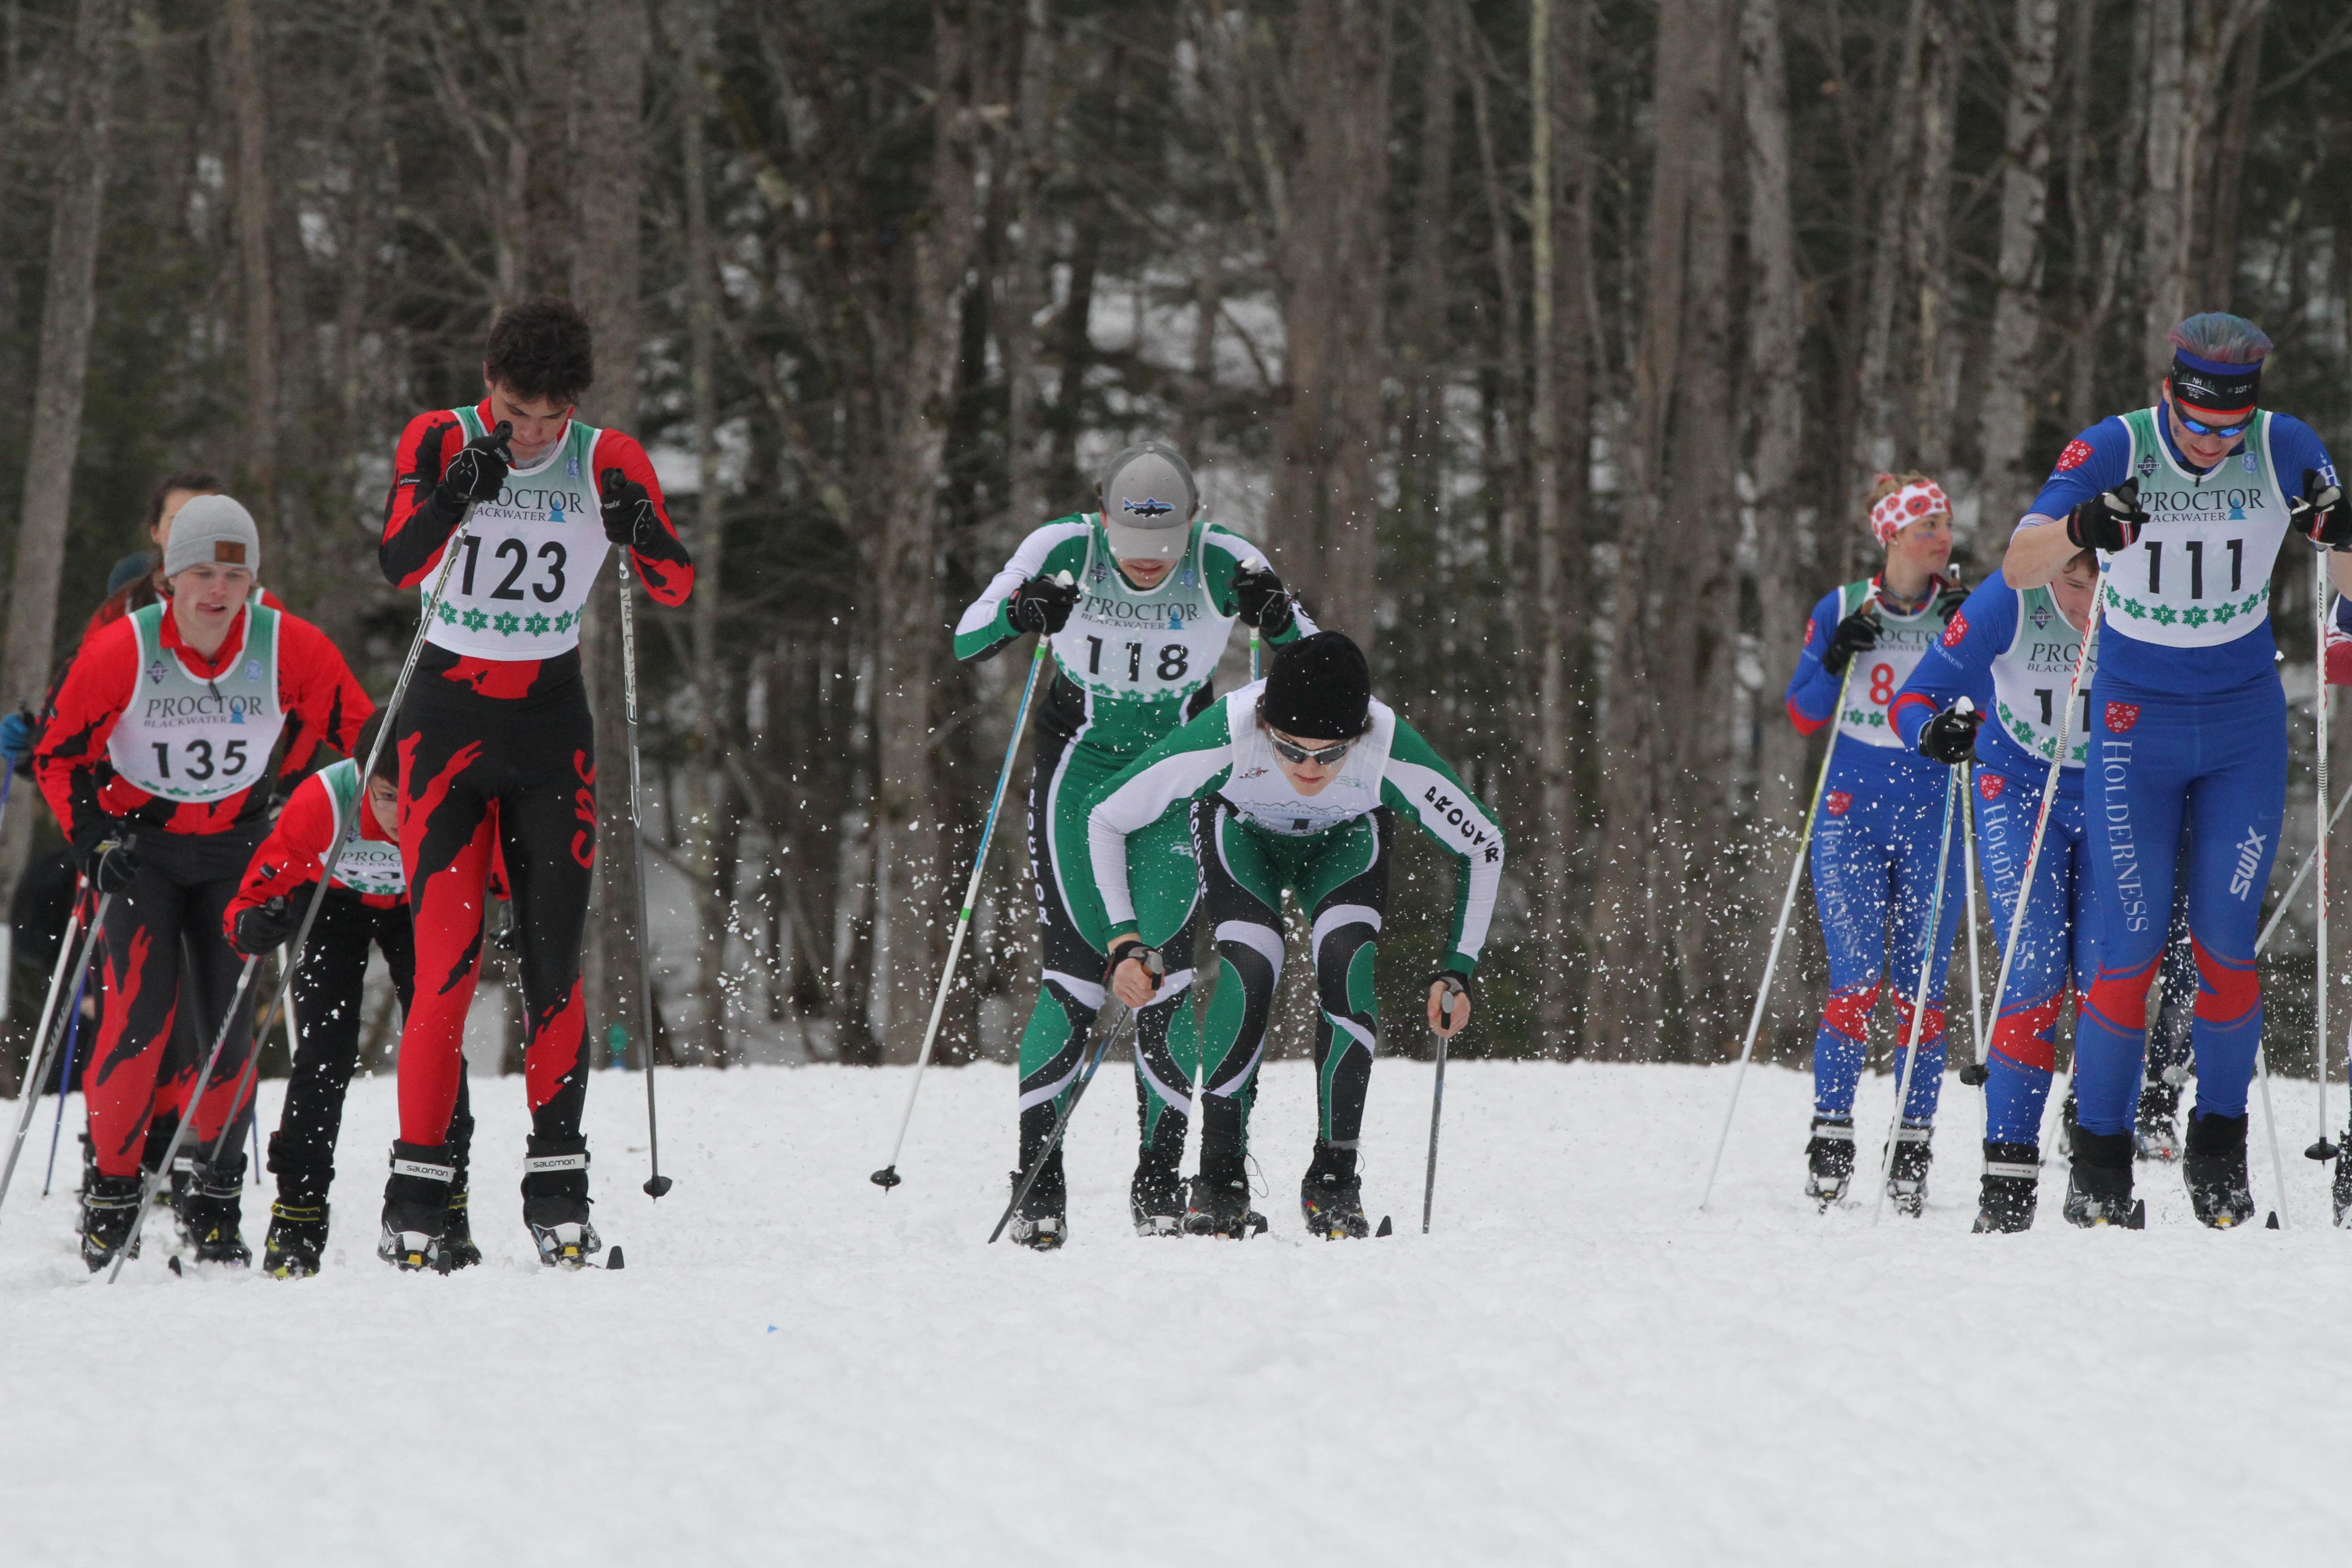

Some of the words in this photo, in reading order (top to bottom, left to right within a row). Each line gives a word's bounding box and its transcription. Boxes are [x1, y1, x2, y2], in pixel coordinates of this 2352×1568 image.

[2186, 386, 2205, 395] NORDIC
[2192, 377, 2202, 385] NH
[2235, 385, 2247, 394] 2017
[482, 486, 584, 513] OCTOR
[2140, 489, 2265, 512] PROCTOR
[475, 507, 546, 521] ACKWATER
[2149, 512, 2226, 522] ACKWATER
[462, 535, 567, 603] 123
[2145, 539, 2243, 599] 111
[1084, 596, 1201, 621] PROCTOR
[1082, 613, 1168, 630] BLACKWATER
[1881, 629, 1940, 644] OCTO
[1087, 635, 1189, 682] 118
[2029, 643, 2098, 662] PROC
[2027, 663, 2096, 672] BLACKA
[1869, 662, 1895, 706] 8
[146, 696, 263, 718] PROCTOR
[143, 715, 227, 727] BLACKWATER
[152, 739, 247, 780] 135
[1425, 786, 1499, 863] PROCTR
[2102, 739, 2148, 931] HOLDERNESS
[341, 851, 402, 862] PROC
[1189, 801, 1208, 899] ROCTOR
[2230, 826, 2267, 901] swix
[407, 1165, 448, 1177] salomon
